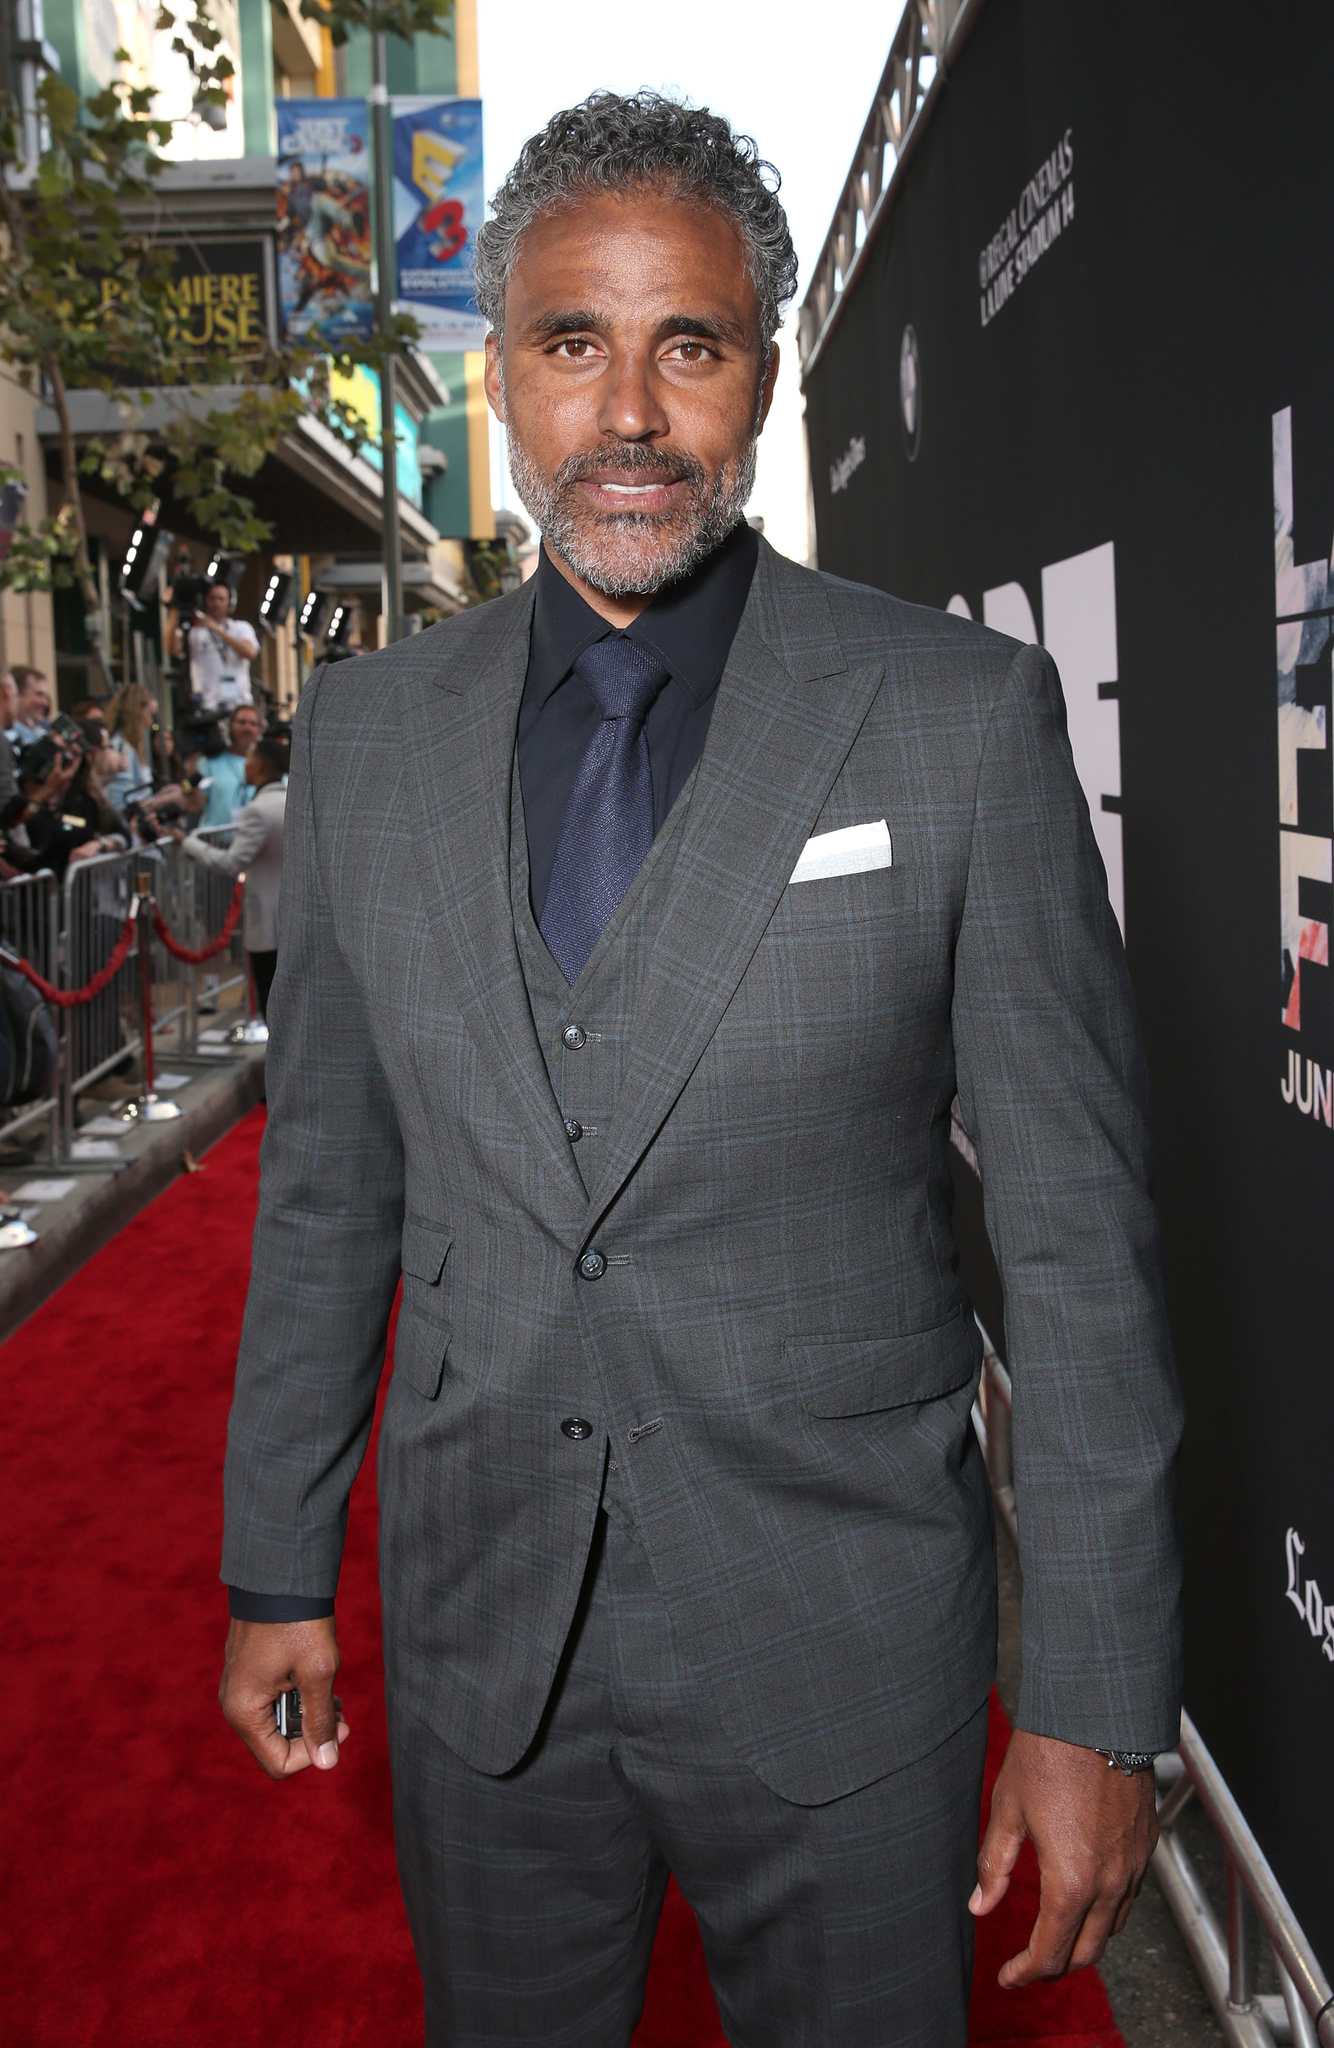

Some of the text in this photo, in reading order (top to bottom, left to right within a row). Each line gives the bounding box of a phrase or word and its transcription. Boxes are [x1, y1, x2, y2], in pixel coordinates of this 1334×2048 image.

[1019, 127, 1074, 232] CINEMAS
[1015, 199, 1061, 284] STADIUM
[1061, 181, 1075, 228] 14
[101, 272, 259, 308] PMIERE
[1281, 1048, 1334, 1131] JUN
